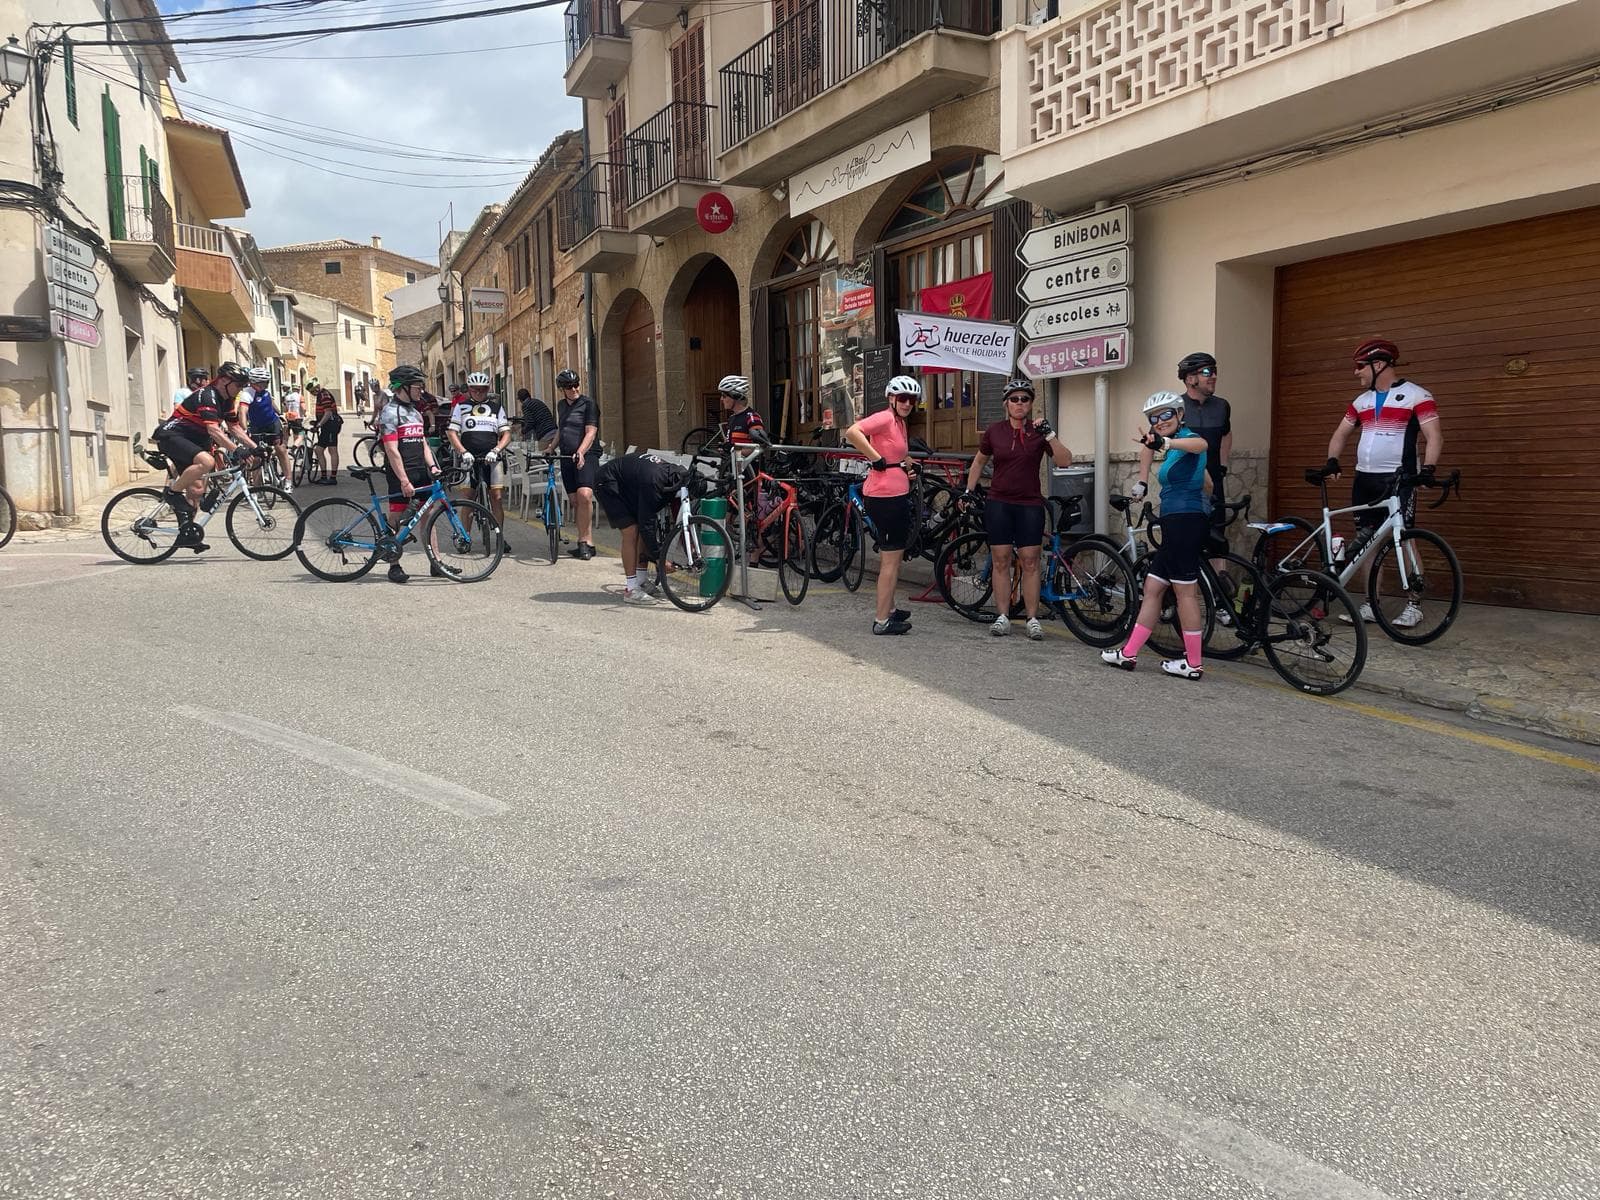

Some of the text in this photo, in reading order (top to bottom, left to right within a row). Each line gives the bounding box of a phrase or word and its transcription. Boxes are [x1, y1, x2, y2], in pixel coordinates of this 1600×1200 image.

[63, 267, 88, 285] centre
[1045, 266, 1100, 289] centre
[1047, 306, 1100, 325] escoles
[944, 326, 1011, 347] huerzeler
[944, 345, 1007, 358] BICYCLE HOLIDAYS
[408, 496, 434, 529] CUBE
